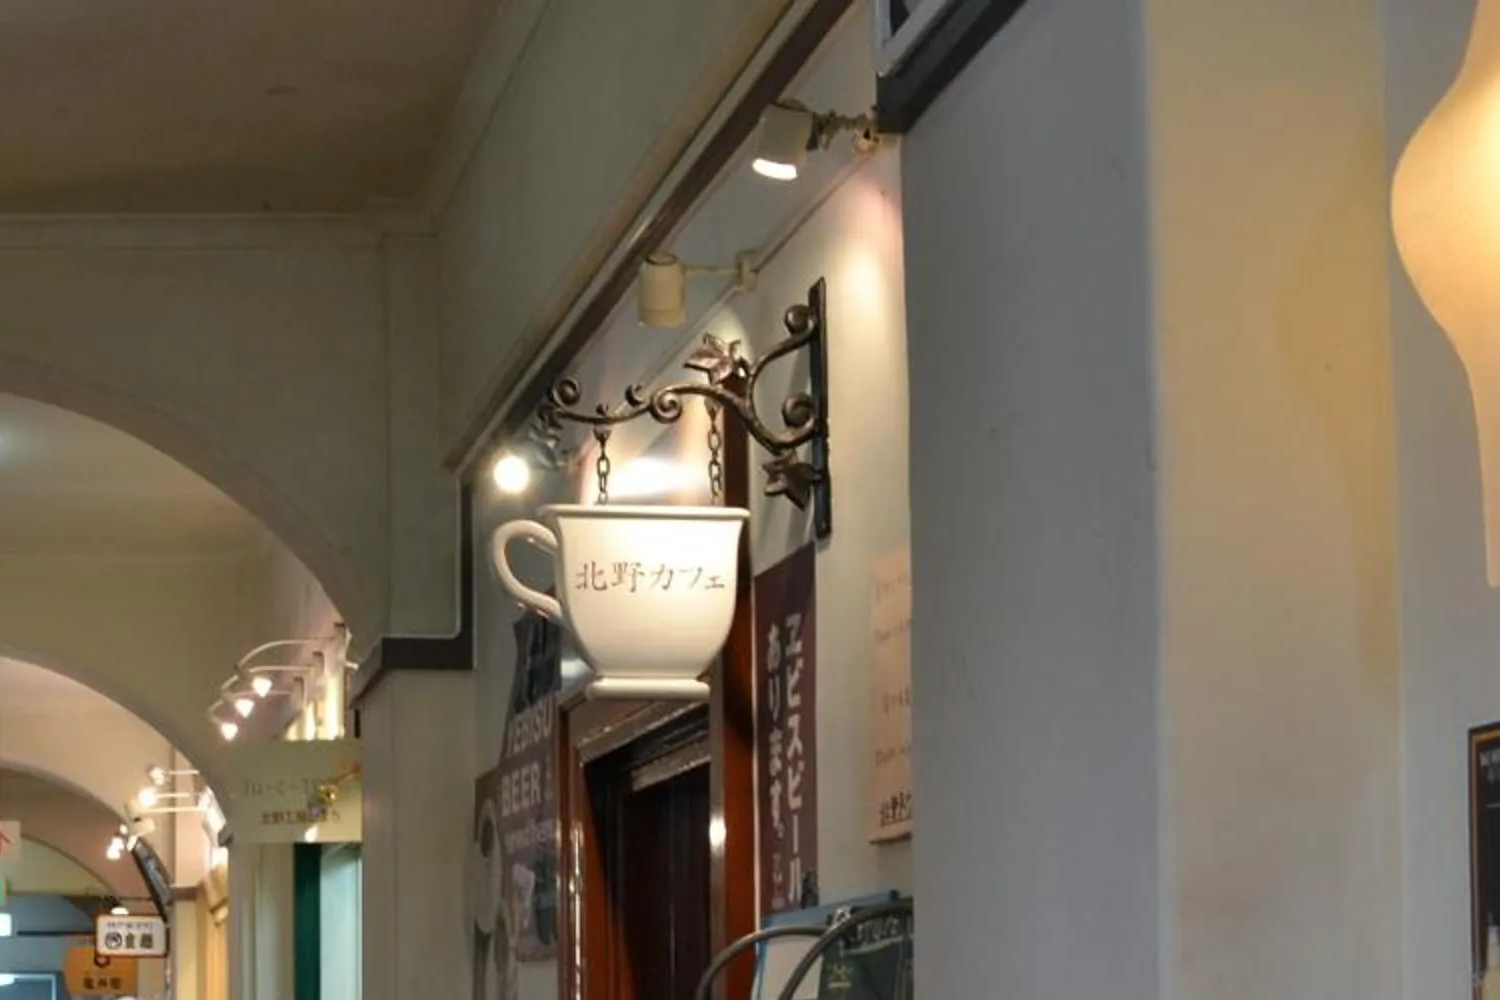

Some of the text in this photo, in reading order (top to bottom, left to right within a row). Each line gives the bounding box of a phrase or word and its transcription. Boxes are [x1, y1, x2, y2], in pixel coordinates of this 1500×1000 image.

[575, 560, 726, 593] 北野カフェ
[501, 761, 541, 817] BEER
